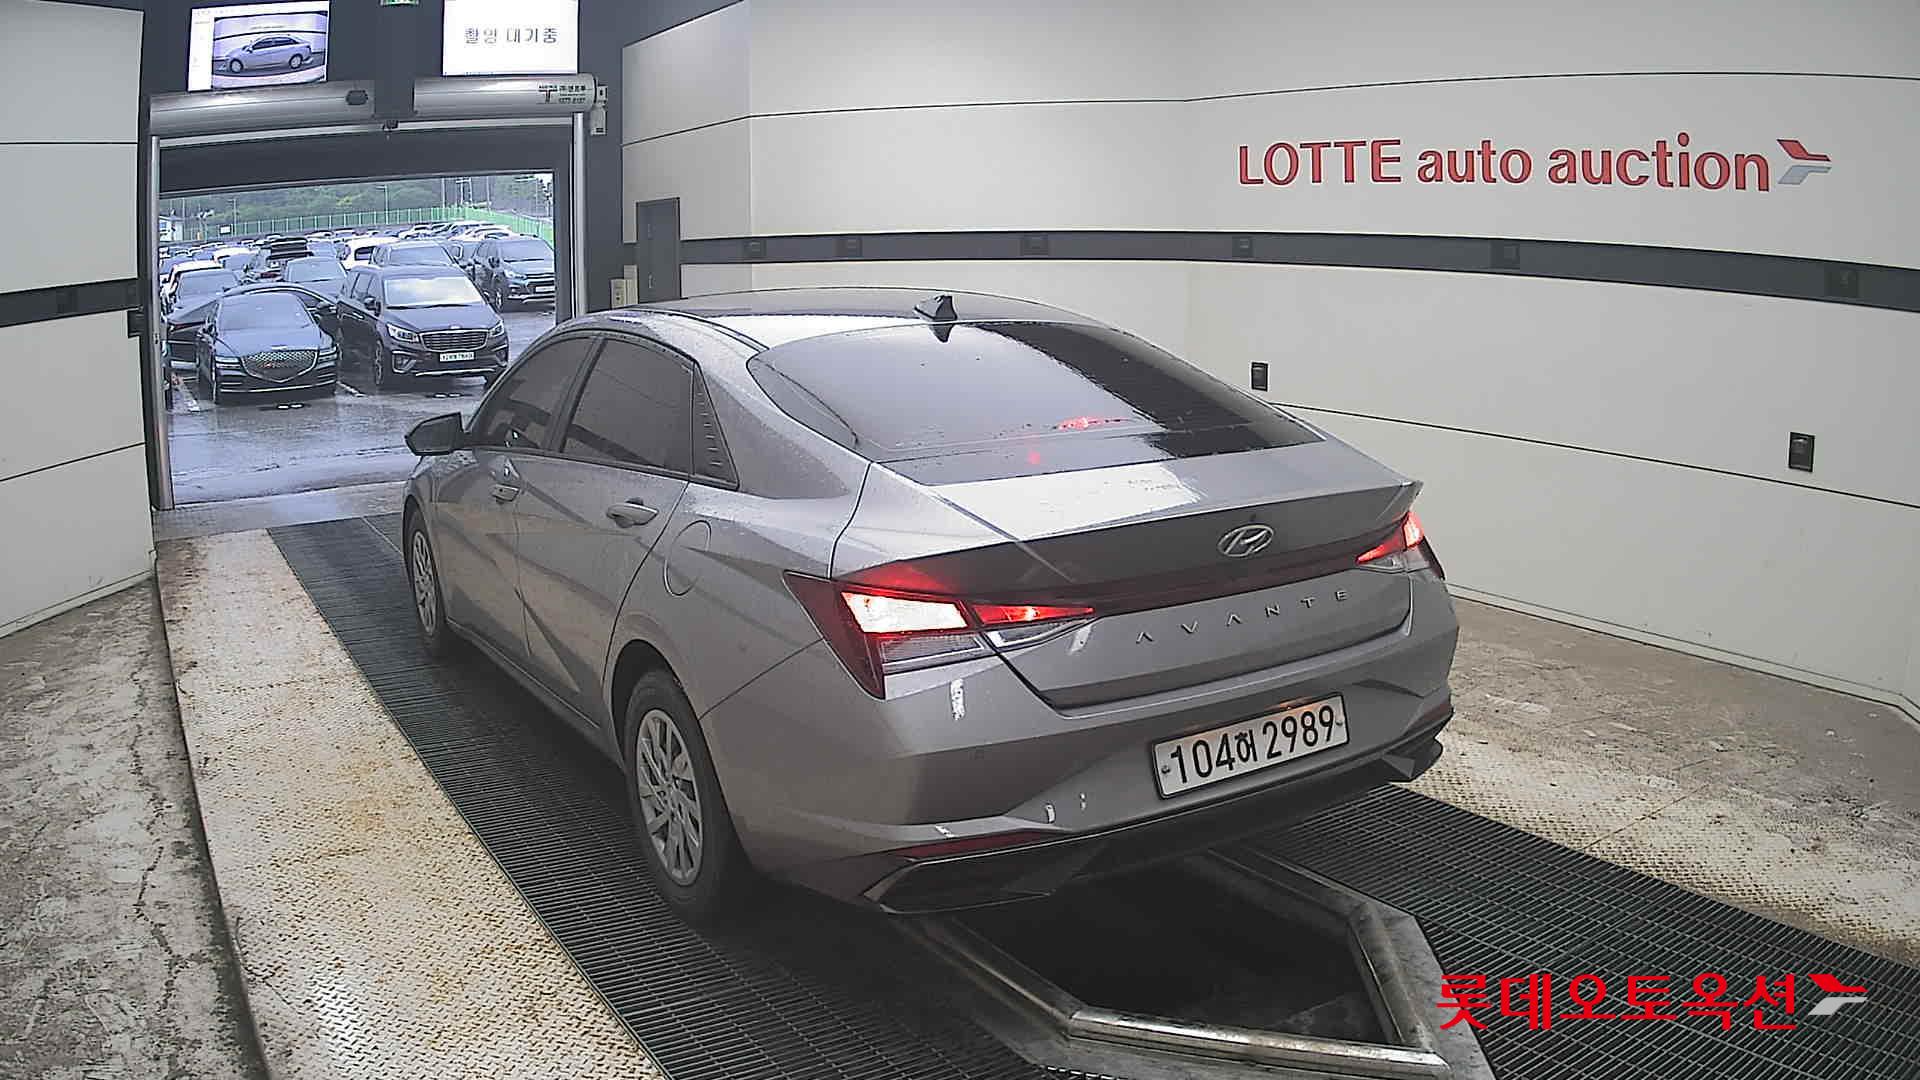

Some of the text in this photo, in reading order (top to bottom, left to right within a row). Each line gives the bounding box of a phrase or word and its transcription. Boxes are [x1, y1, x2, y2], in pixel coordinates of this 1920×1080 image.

[506, 27, 556, 43] 대기중
[1239, 132, 1770, 191] LOTTE auto auction
[1136, 589, 1348, 644] AVANTE
[1262, 705, 1334, 760] 2989
